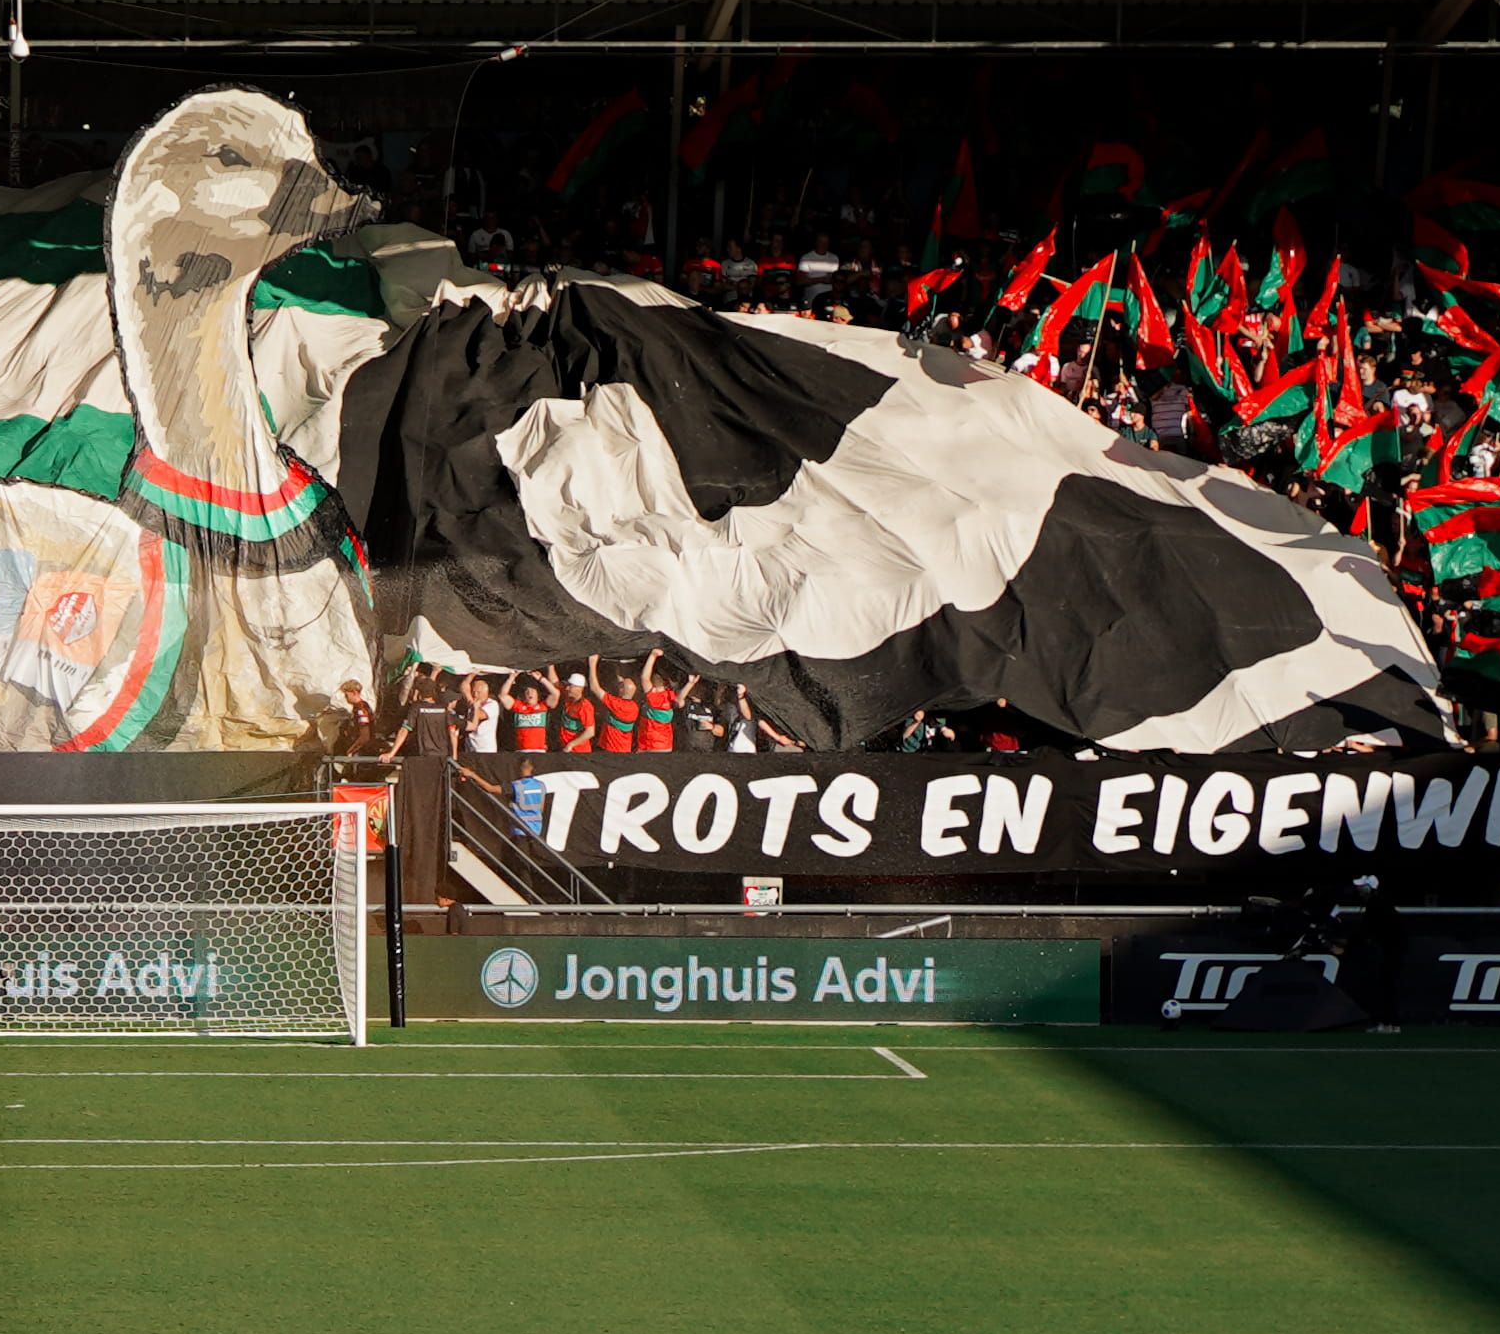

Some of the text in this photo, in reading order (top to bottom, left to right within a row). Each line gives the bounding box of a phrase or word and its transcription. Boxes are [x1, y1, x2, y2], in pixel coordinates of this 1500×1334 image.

[541, 771, 879, 857] TROTS
[921, 774, 1052, 857] EN
[98, 952, 219, 999] Advi
[555, 954, 937, 1012] Jonghuis Advi
